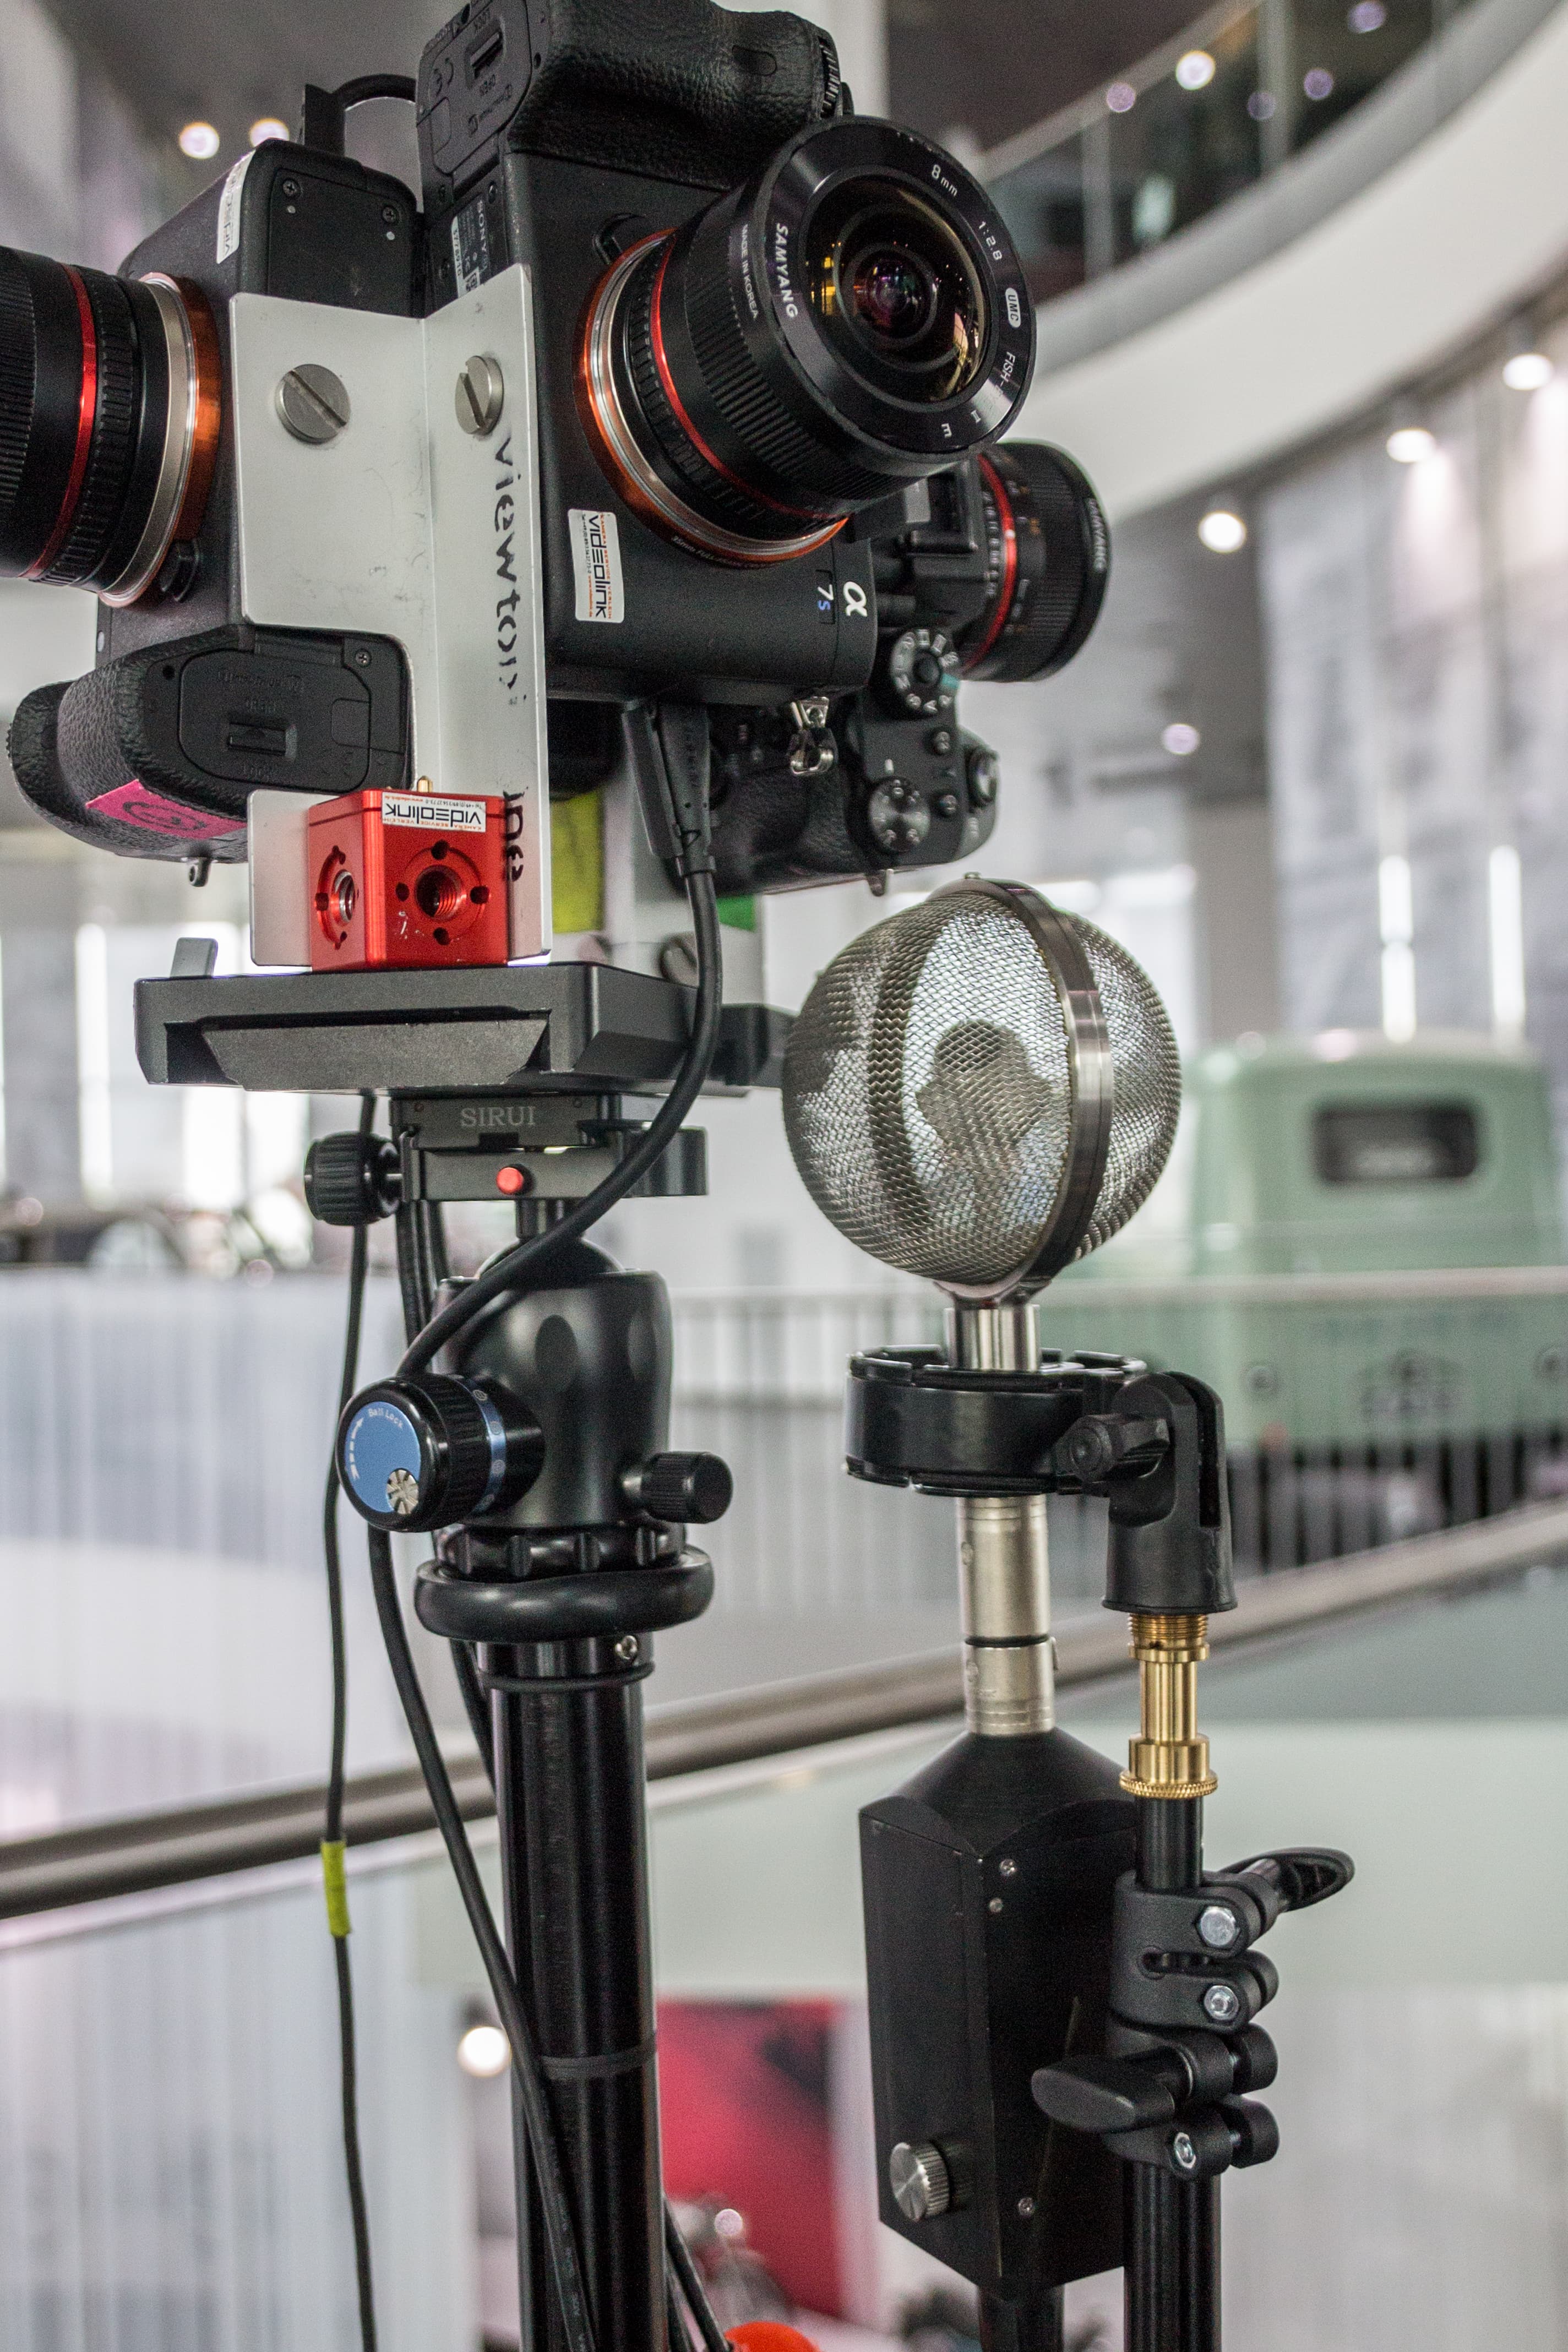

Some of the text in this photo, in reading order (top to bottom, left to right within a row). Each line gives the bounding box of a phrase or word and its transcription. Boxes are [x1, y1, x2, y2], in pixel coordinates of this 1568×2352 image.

[477, 200, 487, 252] SONY
[743, 259, 749, 274] IN
[775, 222, 798, 318] SAMYANG
[744, 275, 758, 320] KOREA
[1007, 293, 1019, 322] UMC
[941, 422, 952, 438] E
[1088, 498, 1107, 573] SAMYANG
[461, 1106, 536, 1127] SIRUI
